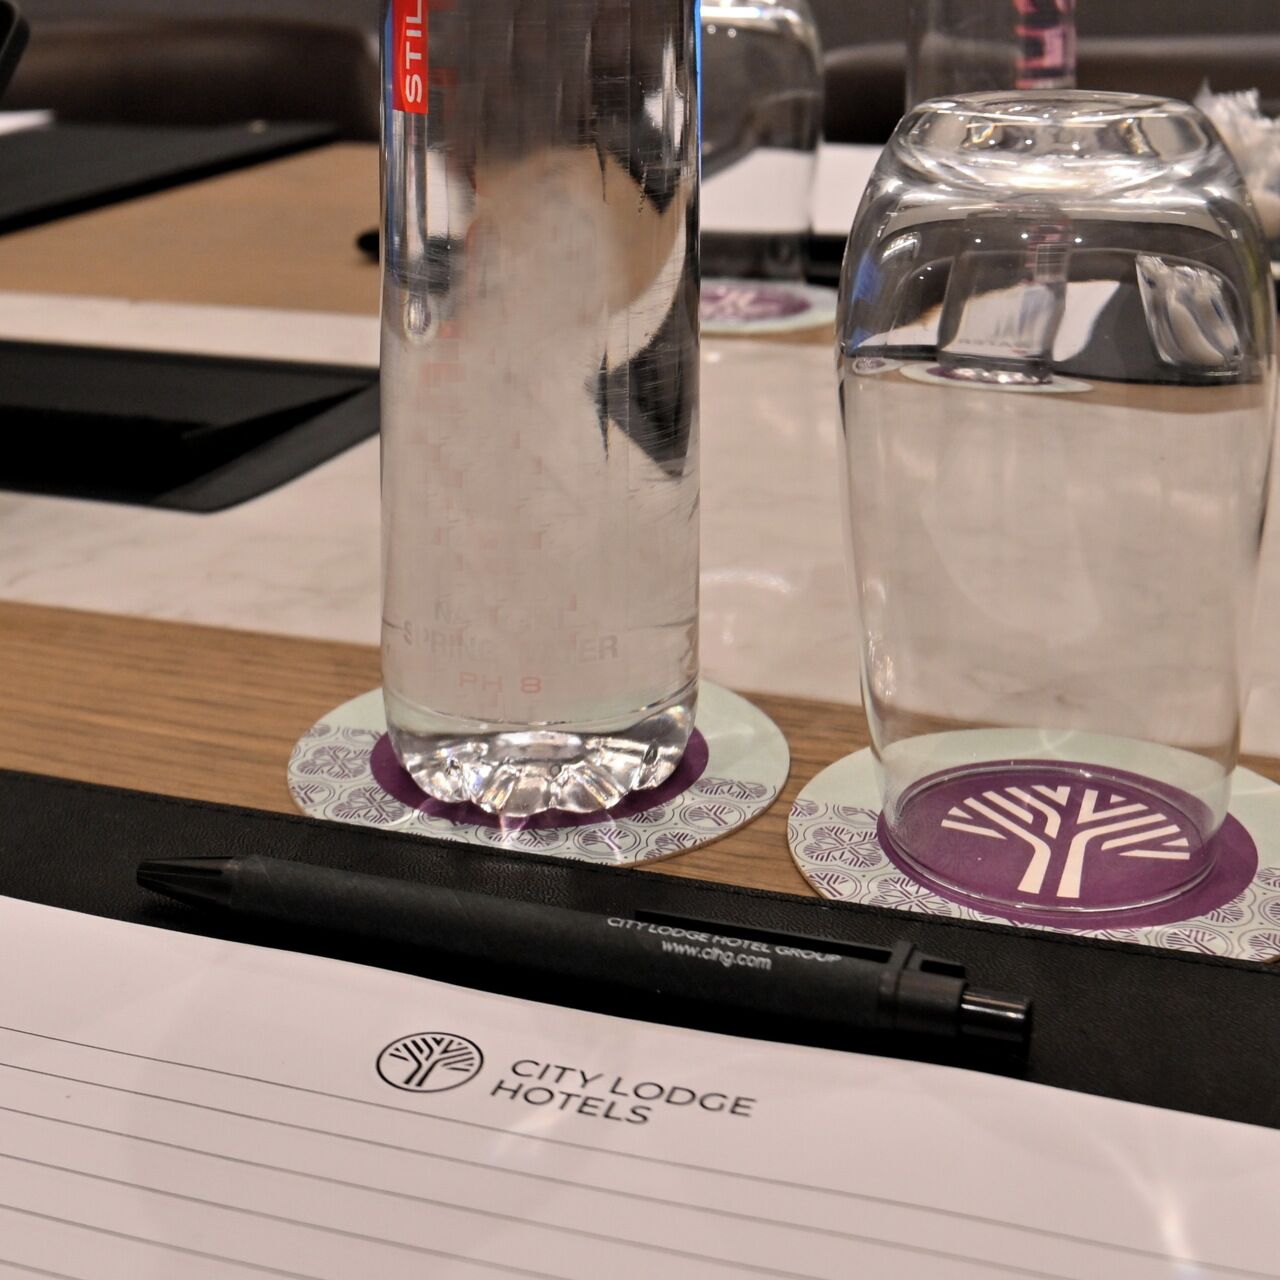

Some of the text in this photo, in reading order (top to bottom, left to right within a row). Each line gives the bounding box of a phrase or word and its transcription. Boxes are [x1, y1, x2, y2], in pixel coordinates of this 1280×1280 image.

[607, 917, 842, 964] CITY LODGE HOTEL GROUP
[661, 940, 772, 970] www.clhg.com
[489, 1079, 654, 1125] HOTELS
[510, 1059, 758, 1118] CITY LODGE
